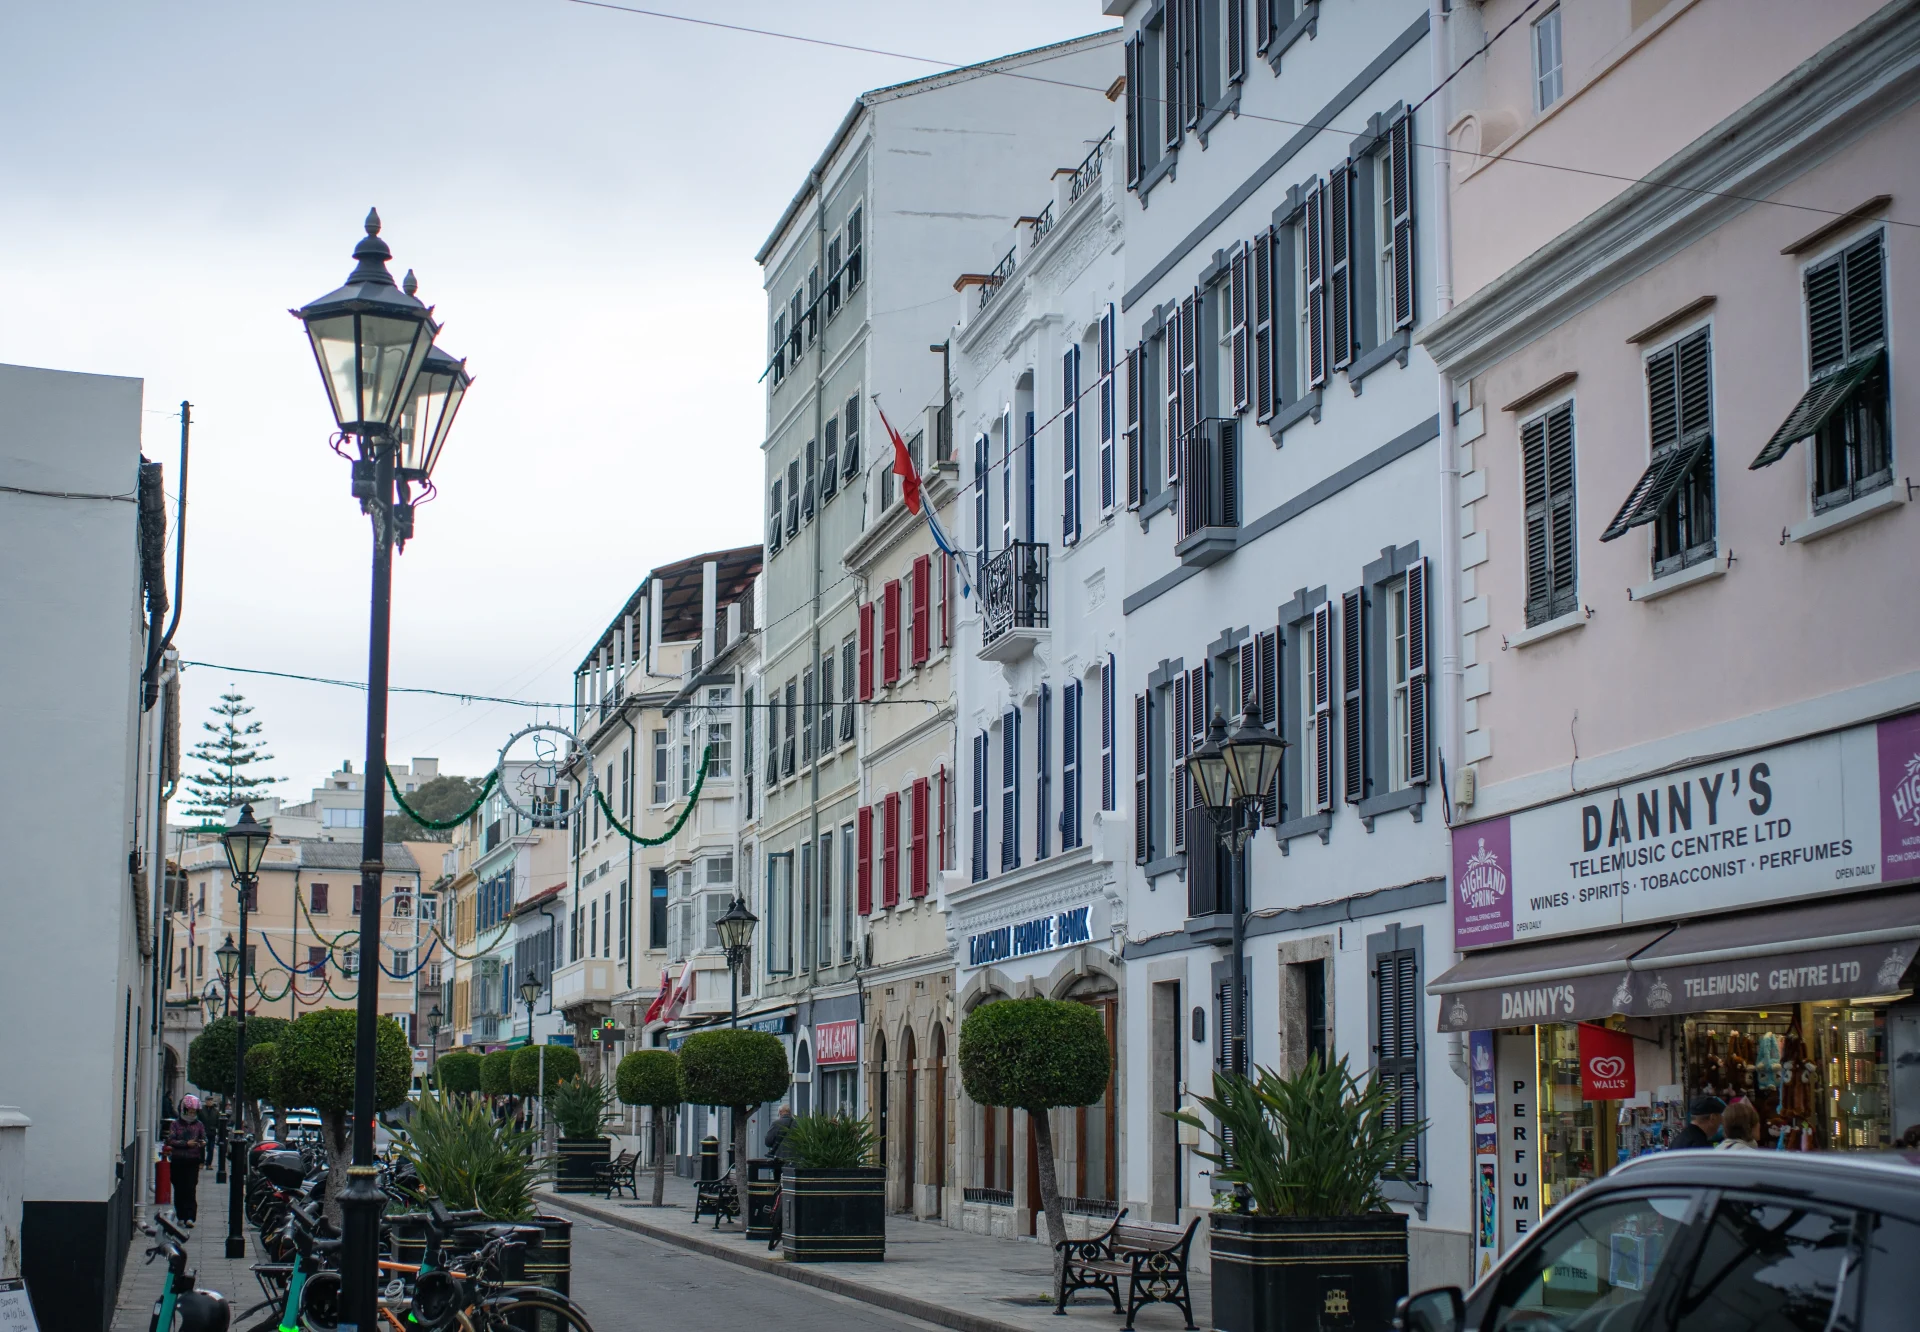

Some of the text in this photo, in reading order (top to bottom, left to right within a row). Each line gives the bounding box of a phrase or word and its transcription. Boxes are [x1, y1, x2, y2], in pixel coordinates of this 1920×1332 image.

[1582, 762, 1772, 853] DANNY'S
[1570, 818, 1792, 878] TELEMUSIC CENTRE LTD
[1460, 866, 1506, 902] HIGHLAND
[1530, 839, 1853, 911] WINES SPIRITS TOBACCONIST PERFUMES
[1835, 864, 1876, 880] OPEN DAILY
[1471, 889, 1495, 909] SPRING
[1013, 916, 1053, 956] PRIVATE
[1058, 906, 1090, 946] BANK
[1516, 920, 1542, 932] OPEN DAILY
[1684, 972, 1760, 998] TELEMUSIC
[1769, 965, 1828, 990] CENTRE
[1832, 961, 1861, 984] LTD
[1501, 985, 1575, 1020] DANNY'S
[817, 1025, 856, 1059] PEAK GYM
[1592, 1079, 1626, 1089] WALL'S
[1513, 1080, 1529, 1233] PERFUME
[1571, 1266, 1588, 1280] FREE
